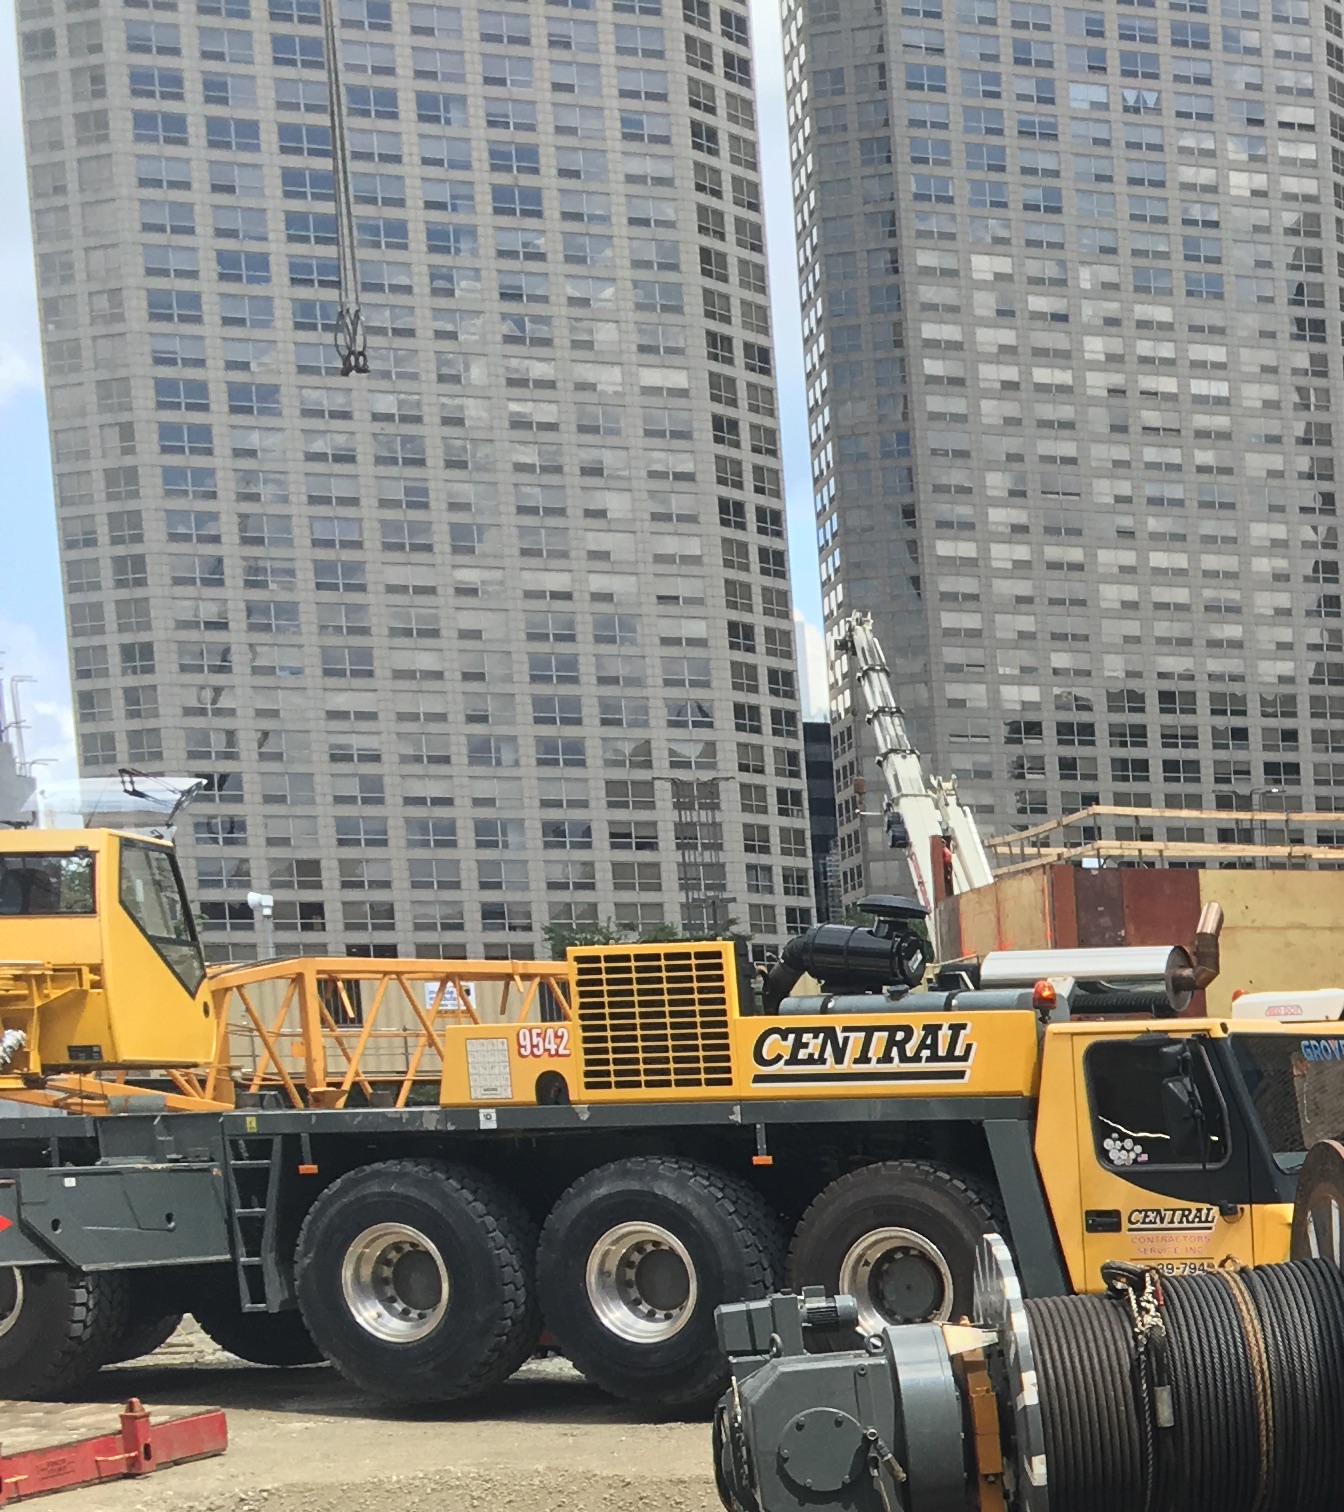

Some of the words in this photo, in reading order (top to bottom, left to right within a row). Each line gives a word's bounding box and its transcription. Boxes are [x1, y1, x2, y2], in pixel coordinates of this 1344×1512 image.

[517, 1027, 570, 1057] 9542
[753, 1022, 977, 1070] CENTRAL
[1128, 1208, 1218, 1225] CENTRAL
[1131, 1235, 1211, 1244] CONTRACTORS
